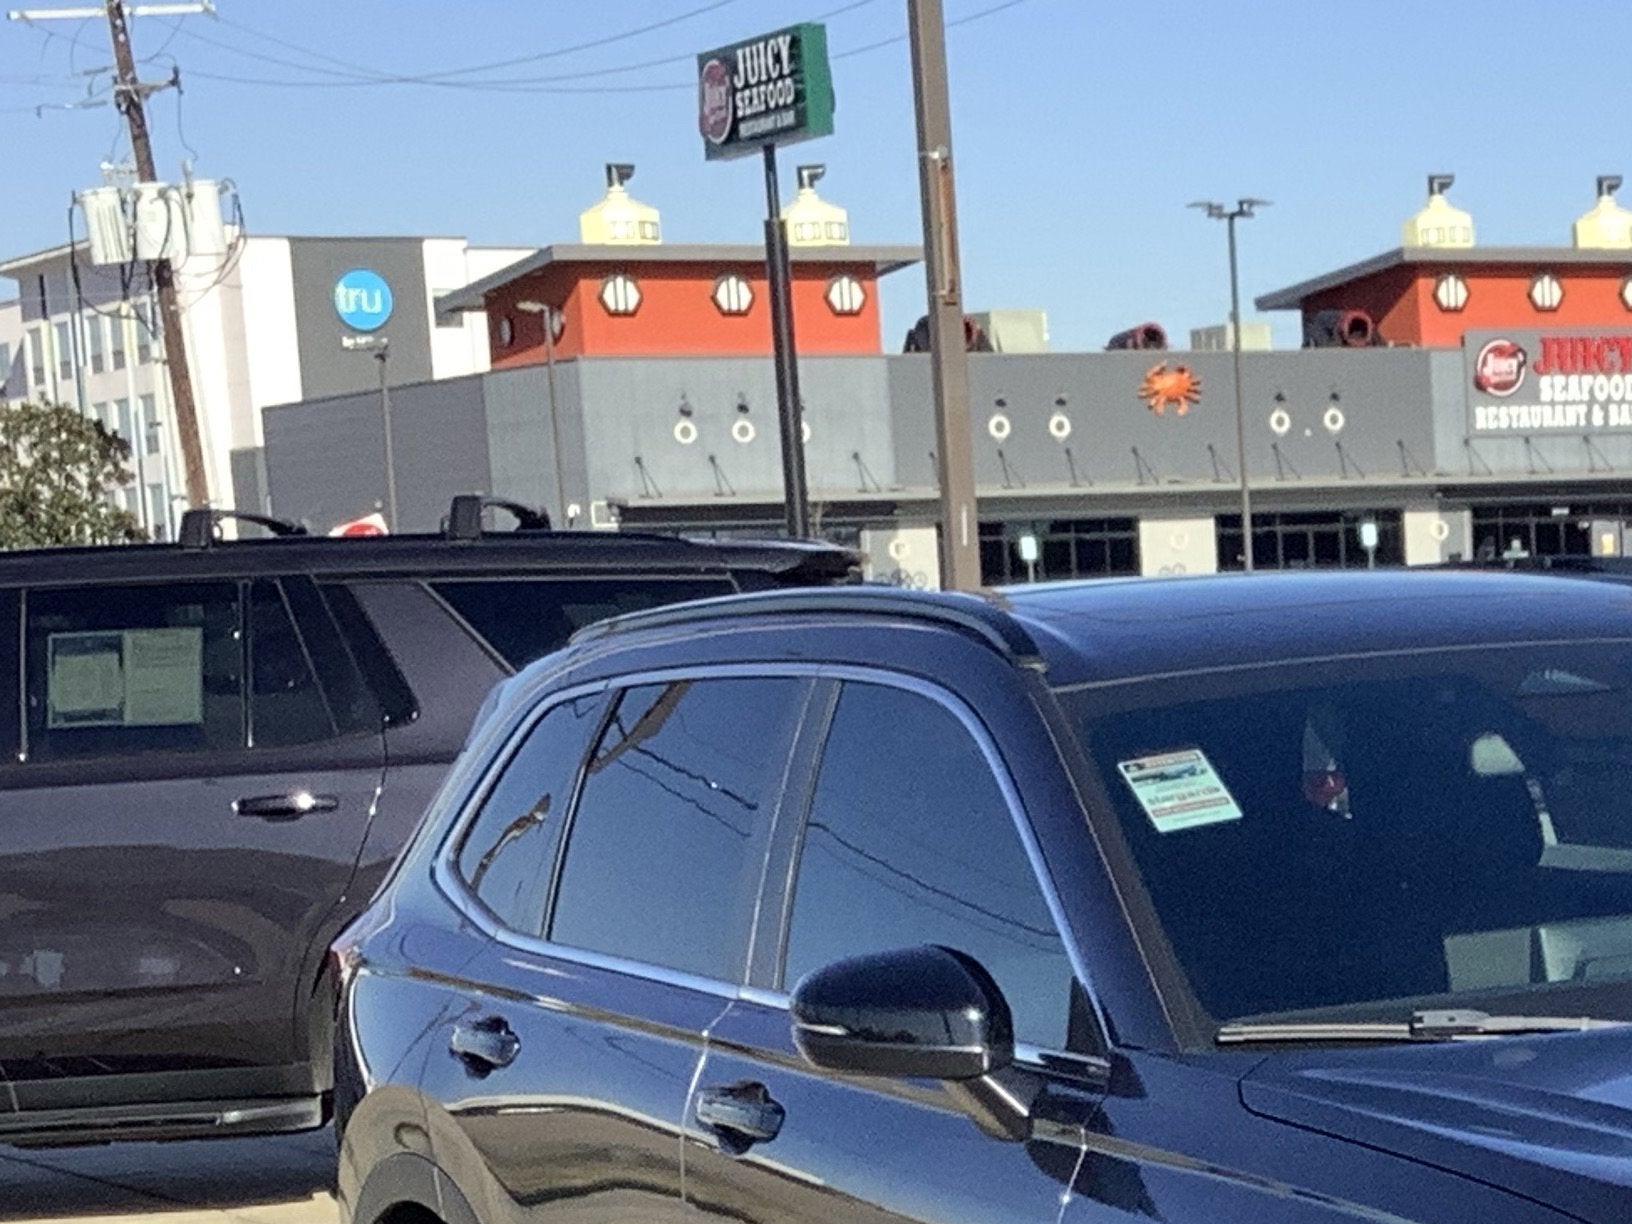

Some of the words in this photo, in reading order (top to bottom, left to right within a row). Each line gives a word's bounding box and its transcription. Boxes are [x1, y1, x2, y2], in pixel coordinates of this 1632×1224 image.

[733, 34, 792, 89] JUICY
[735, 77, 795, 118] SEAFOOD
[335, 282, 382, 314] tru
[1475, 404, 1588, 430] RESTAURANT
[1591, 406, 1604, 426] &
